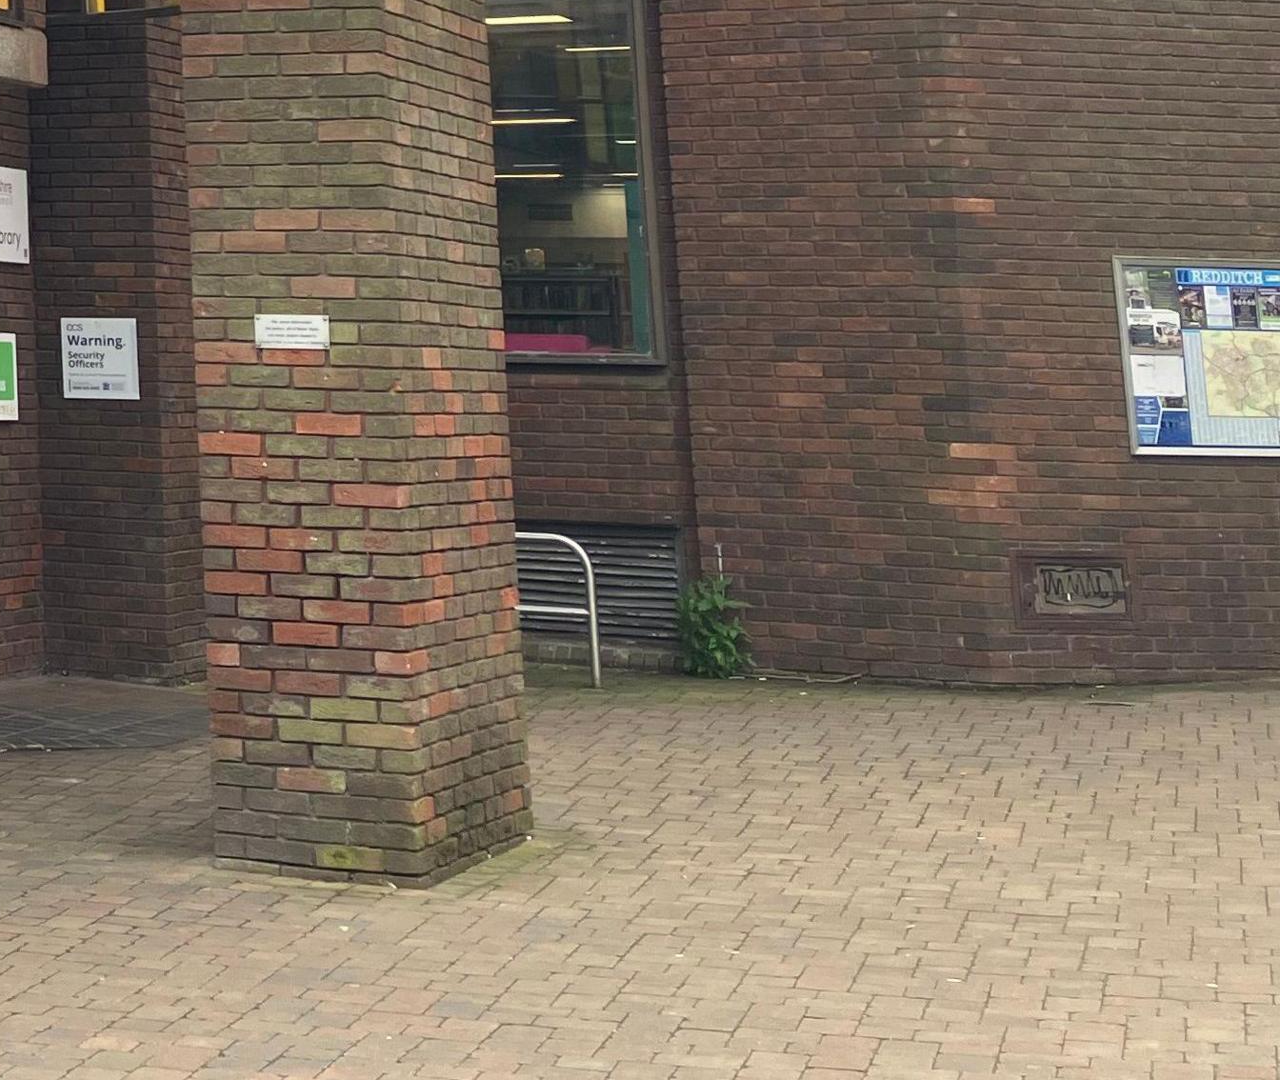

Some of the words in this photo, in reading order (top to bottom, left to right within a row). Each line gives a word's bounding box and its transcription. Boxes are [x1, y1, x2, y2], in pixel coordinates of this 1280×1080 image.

[1191, 270, 1264, 285] REDDITCH
[67, 350, 105, 361] Security
[67, 360, 105, 369] Officers
